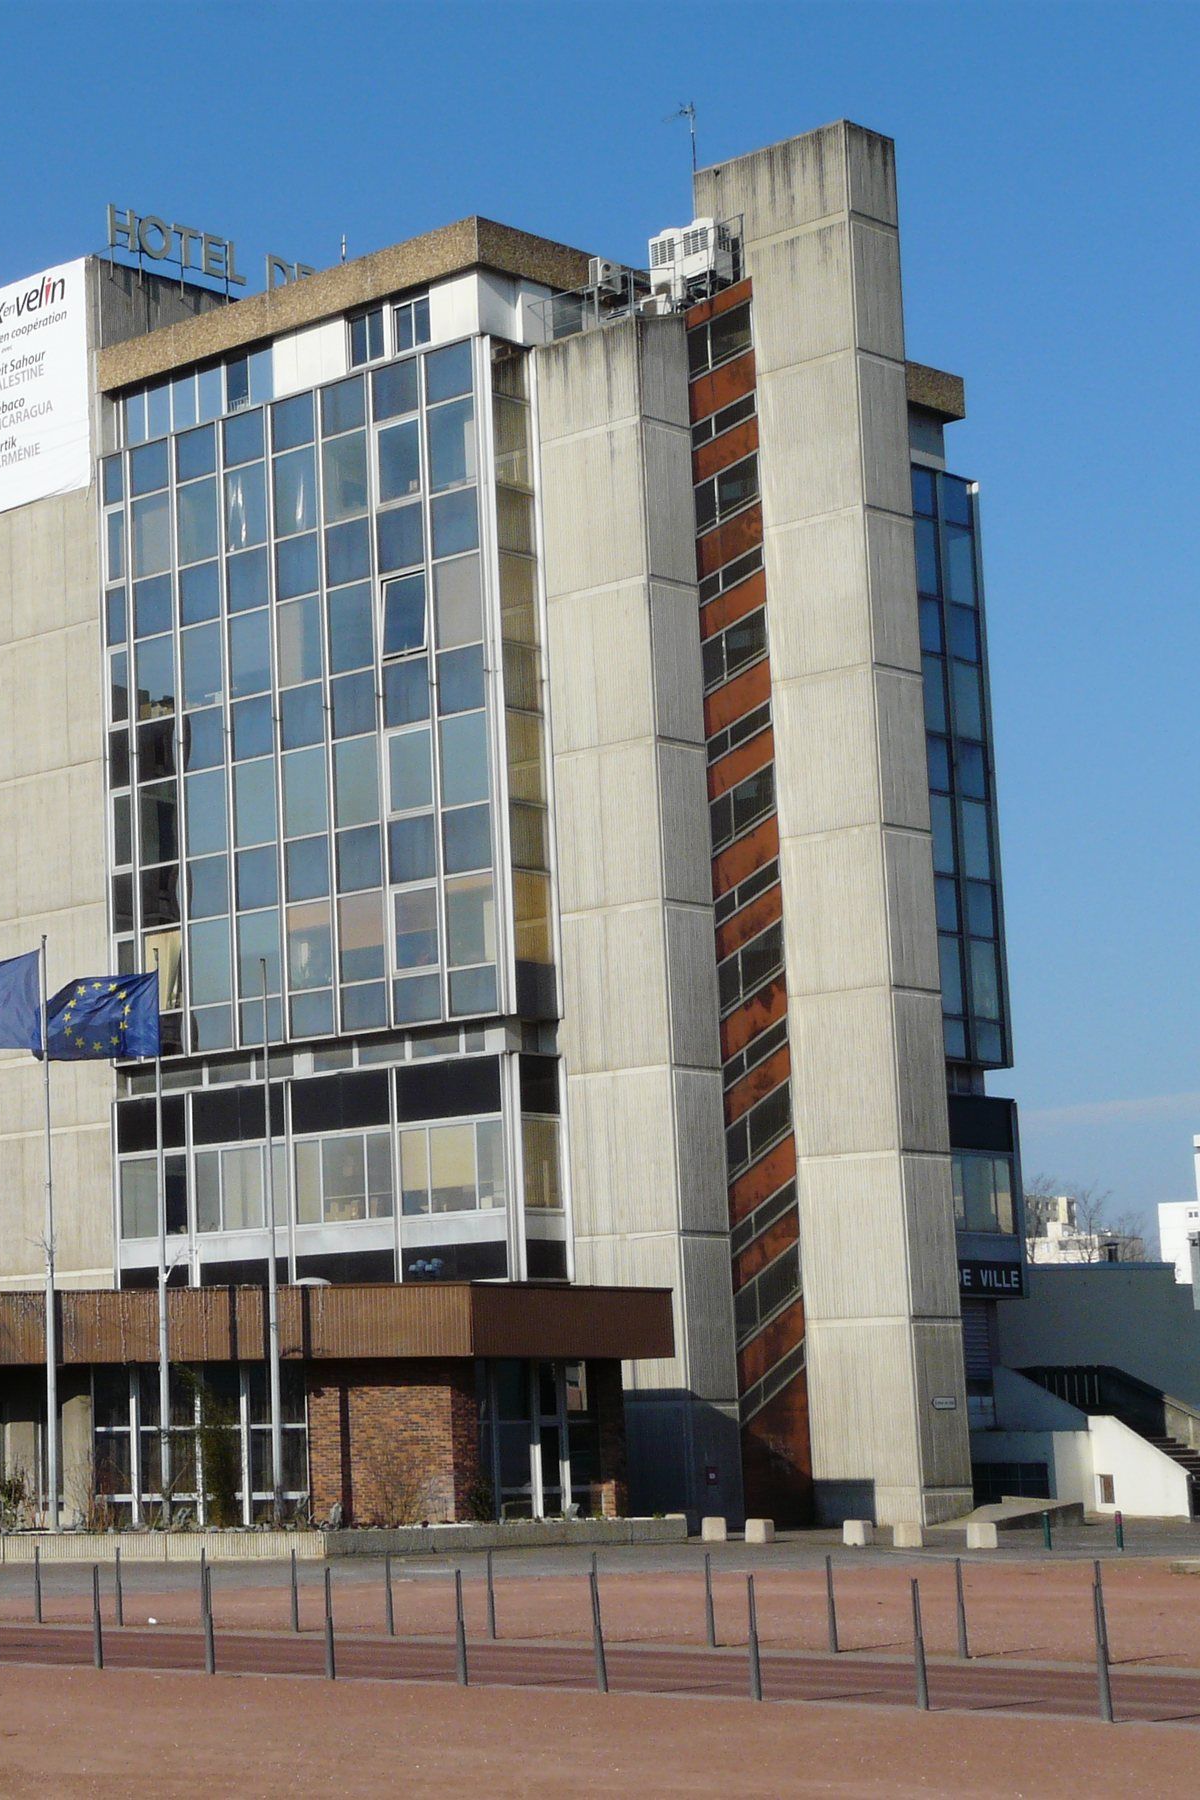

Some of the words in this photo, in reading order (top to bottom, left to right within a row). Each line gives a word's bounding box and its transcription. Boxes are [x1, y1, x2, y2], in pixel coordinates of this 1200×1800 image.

[107, 204, 246, 286] HOTEL
[3, 304, 15, 317] en
[16, 276, 65, 317] velin
[0, 331, 10, 343] en
[11, 310, 68, 339] coopération
[10, 351, 46, 373] Sahour
[959, 1268, 972, 1286] E
[980, 1268, 1020, 1288] VILLE
